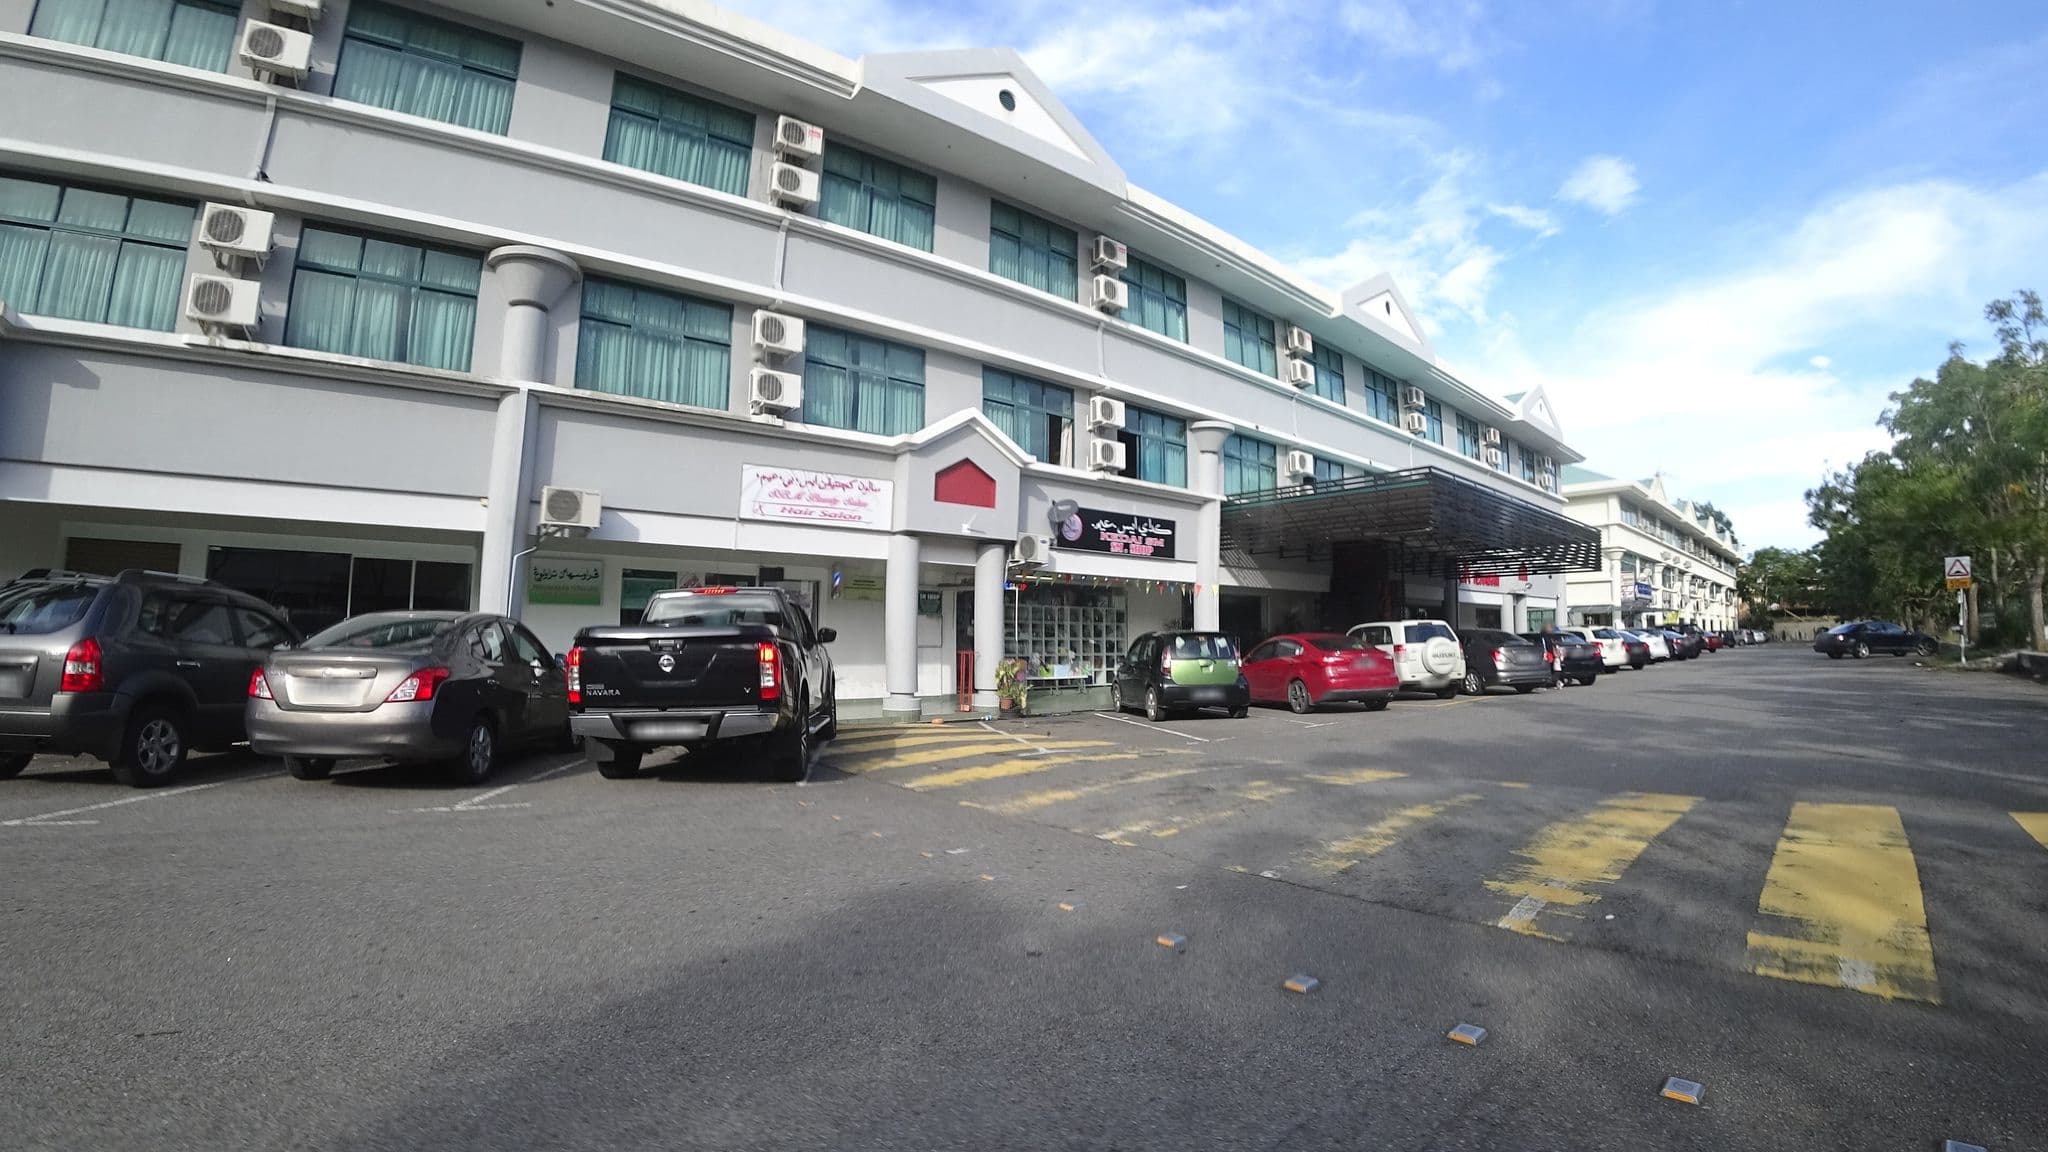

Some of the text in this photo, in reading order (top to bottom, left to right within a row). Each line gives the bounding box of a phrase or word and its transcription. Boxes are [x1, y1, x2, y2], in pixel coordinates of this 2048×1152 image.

[780, 507, 862, 520] Hair Salon
[1099, 531, 1142, 545] KEDAI
